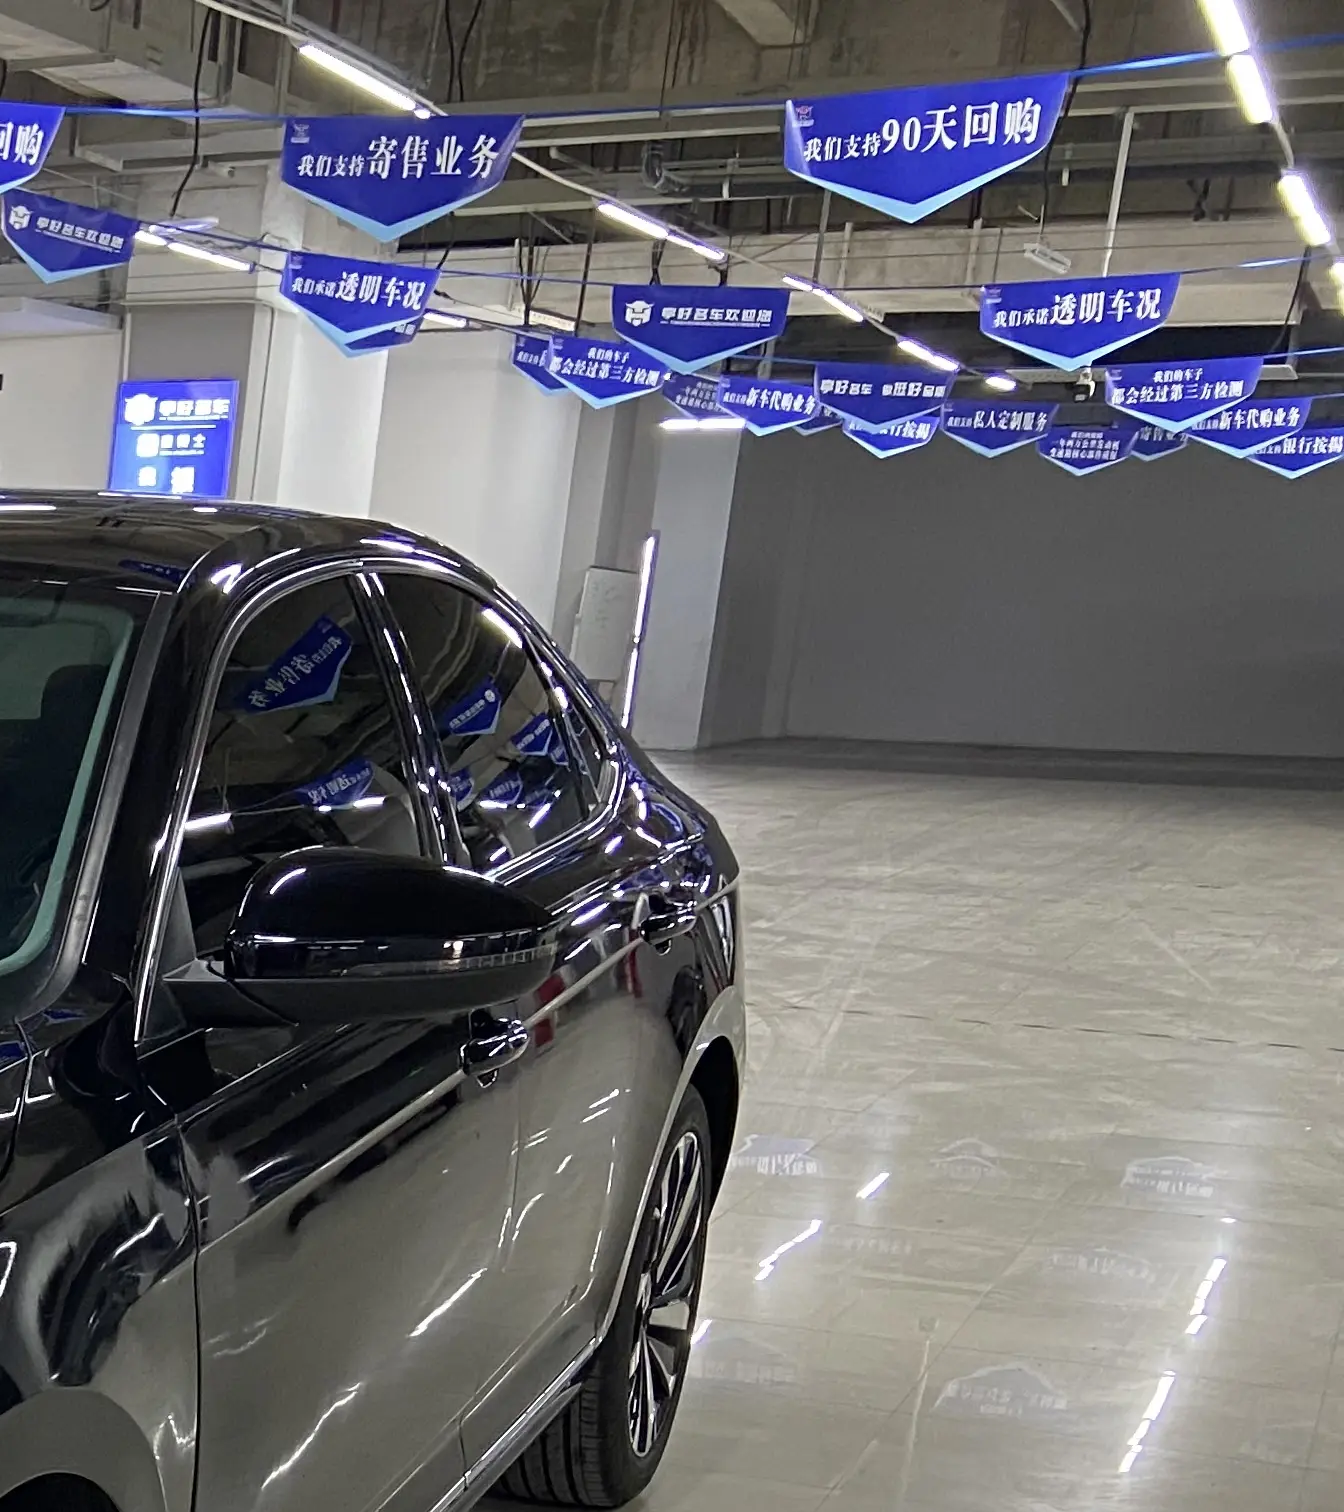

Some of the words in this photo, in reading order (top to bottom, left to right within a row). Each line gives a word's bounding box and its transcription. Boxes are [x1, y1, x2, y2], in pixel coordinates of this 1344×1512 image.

[803, 97, 1042, 163] 我们支持90天回购
[297, 134, 499, 179] 我们支持寄售业务
[291, 271, 427, 311] 我们承诺透明车况
[992, 287, 1163, 328] 我们承诺透明车况
[548, 356, 661, 387] 都会经过第三方检测
[1152, 367, 1203, 383] 我们的车子
[1111, 379, 1245, 405] 都会经过第三方检测
